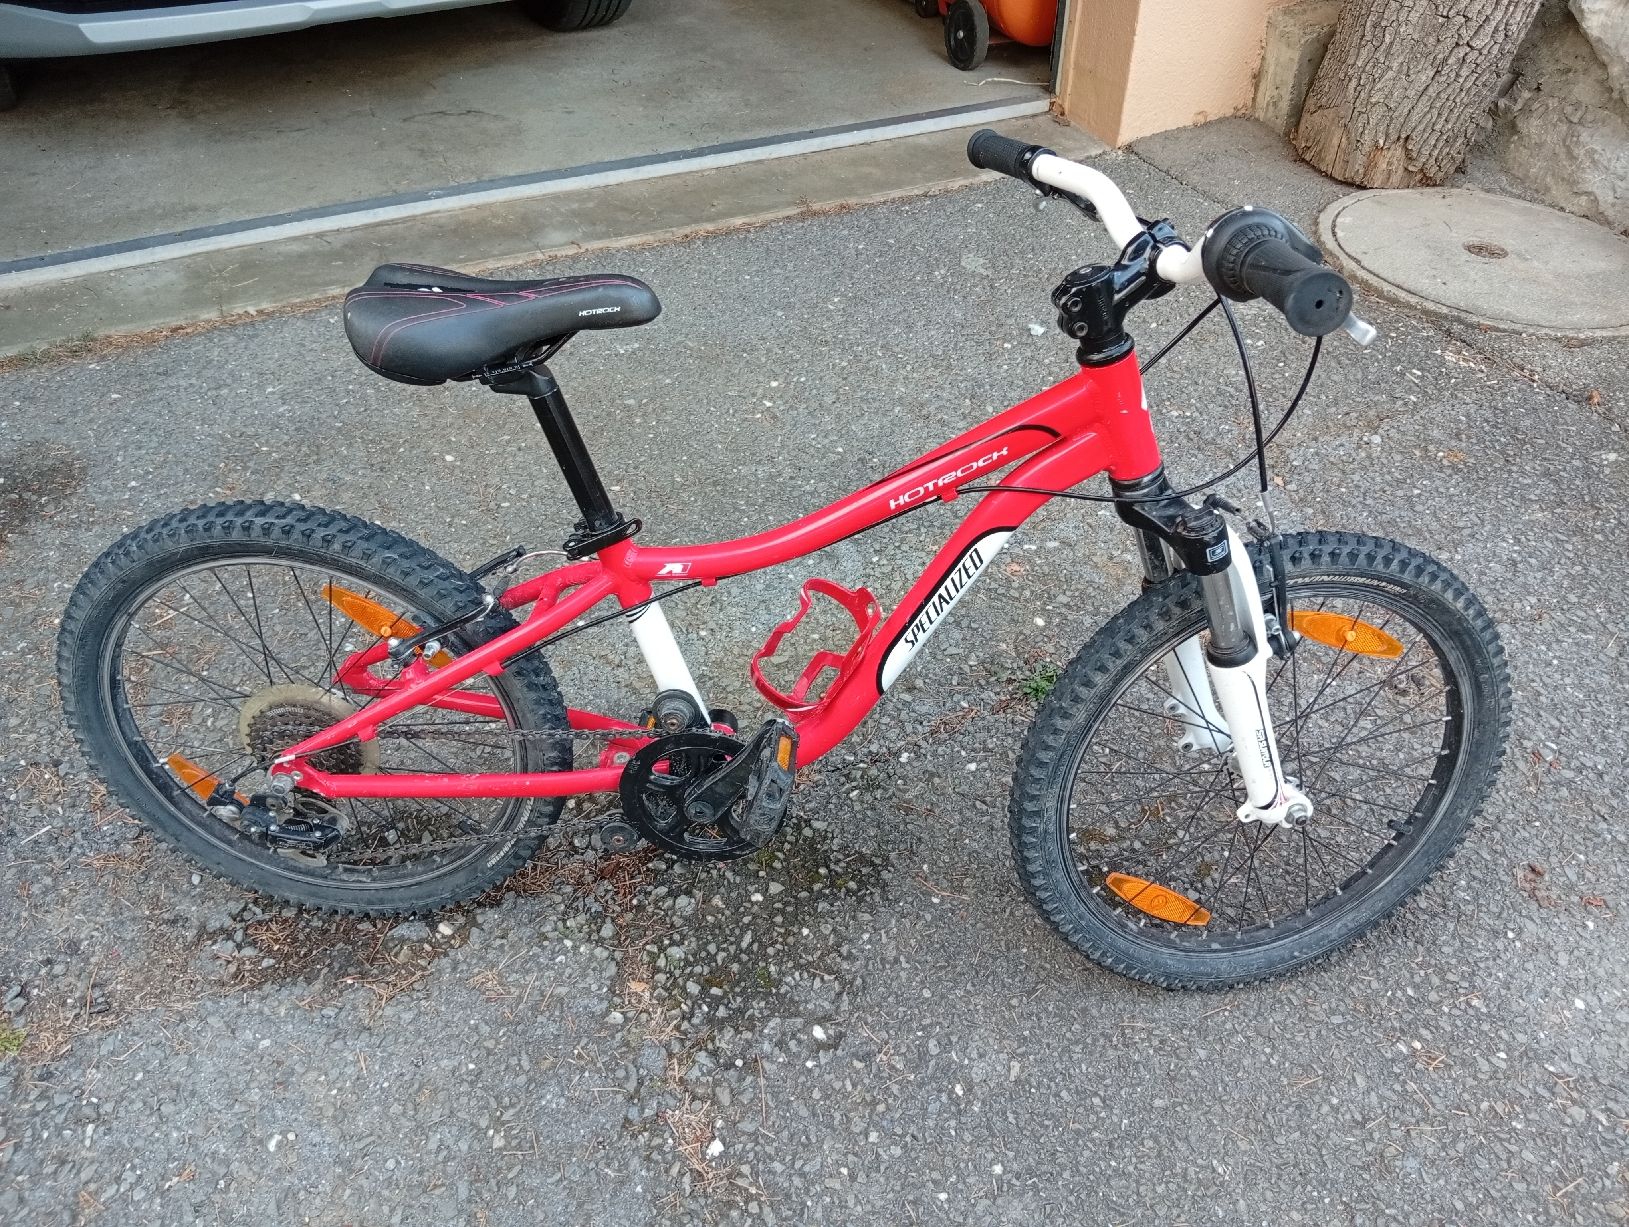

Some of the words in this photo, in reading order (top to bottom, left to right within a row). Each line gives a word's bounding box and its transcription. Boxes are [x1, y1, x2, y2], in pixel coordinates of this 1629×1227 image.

[578, 305, 621, 317] HOTROCK
[889, 446, 1009, 510] HOTROCK
[904, 547, 985, 652] SPECIALIZED
